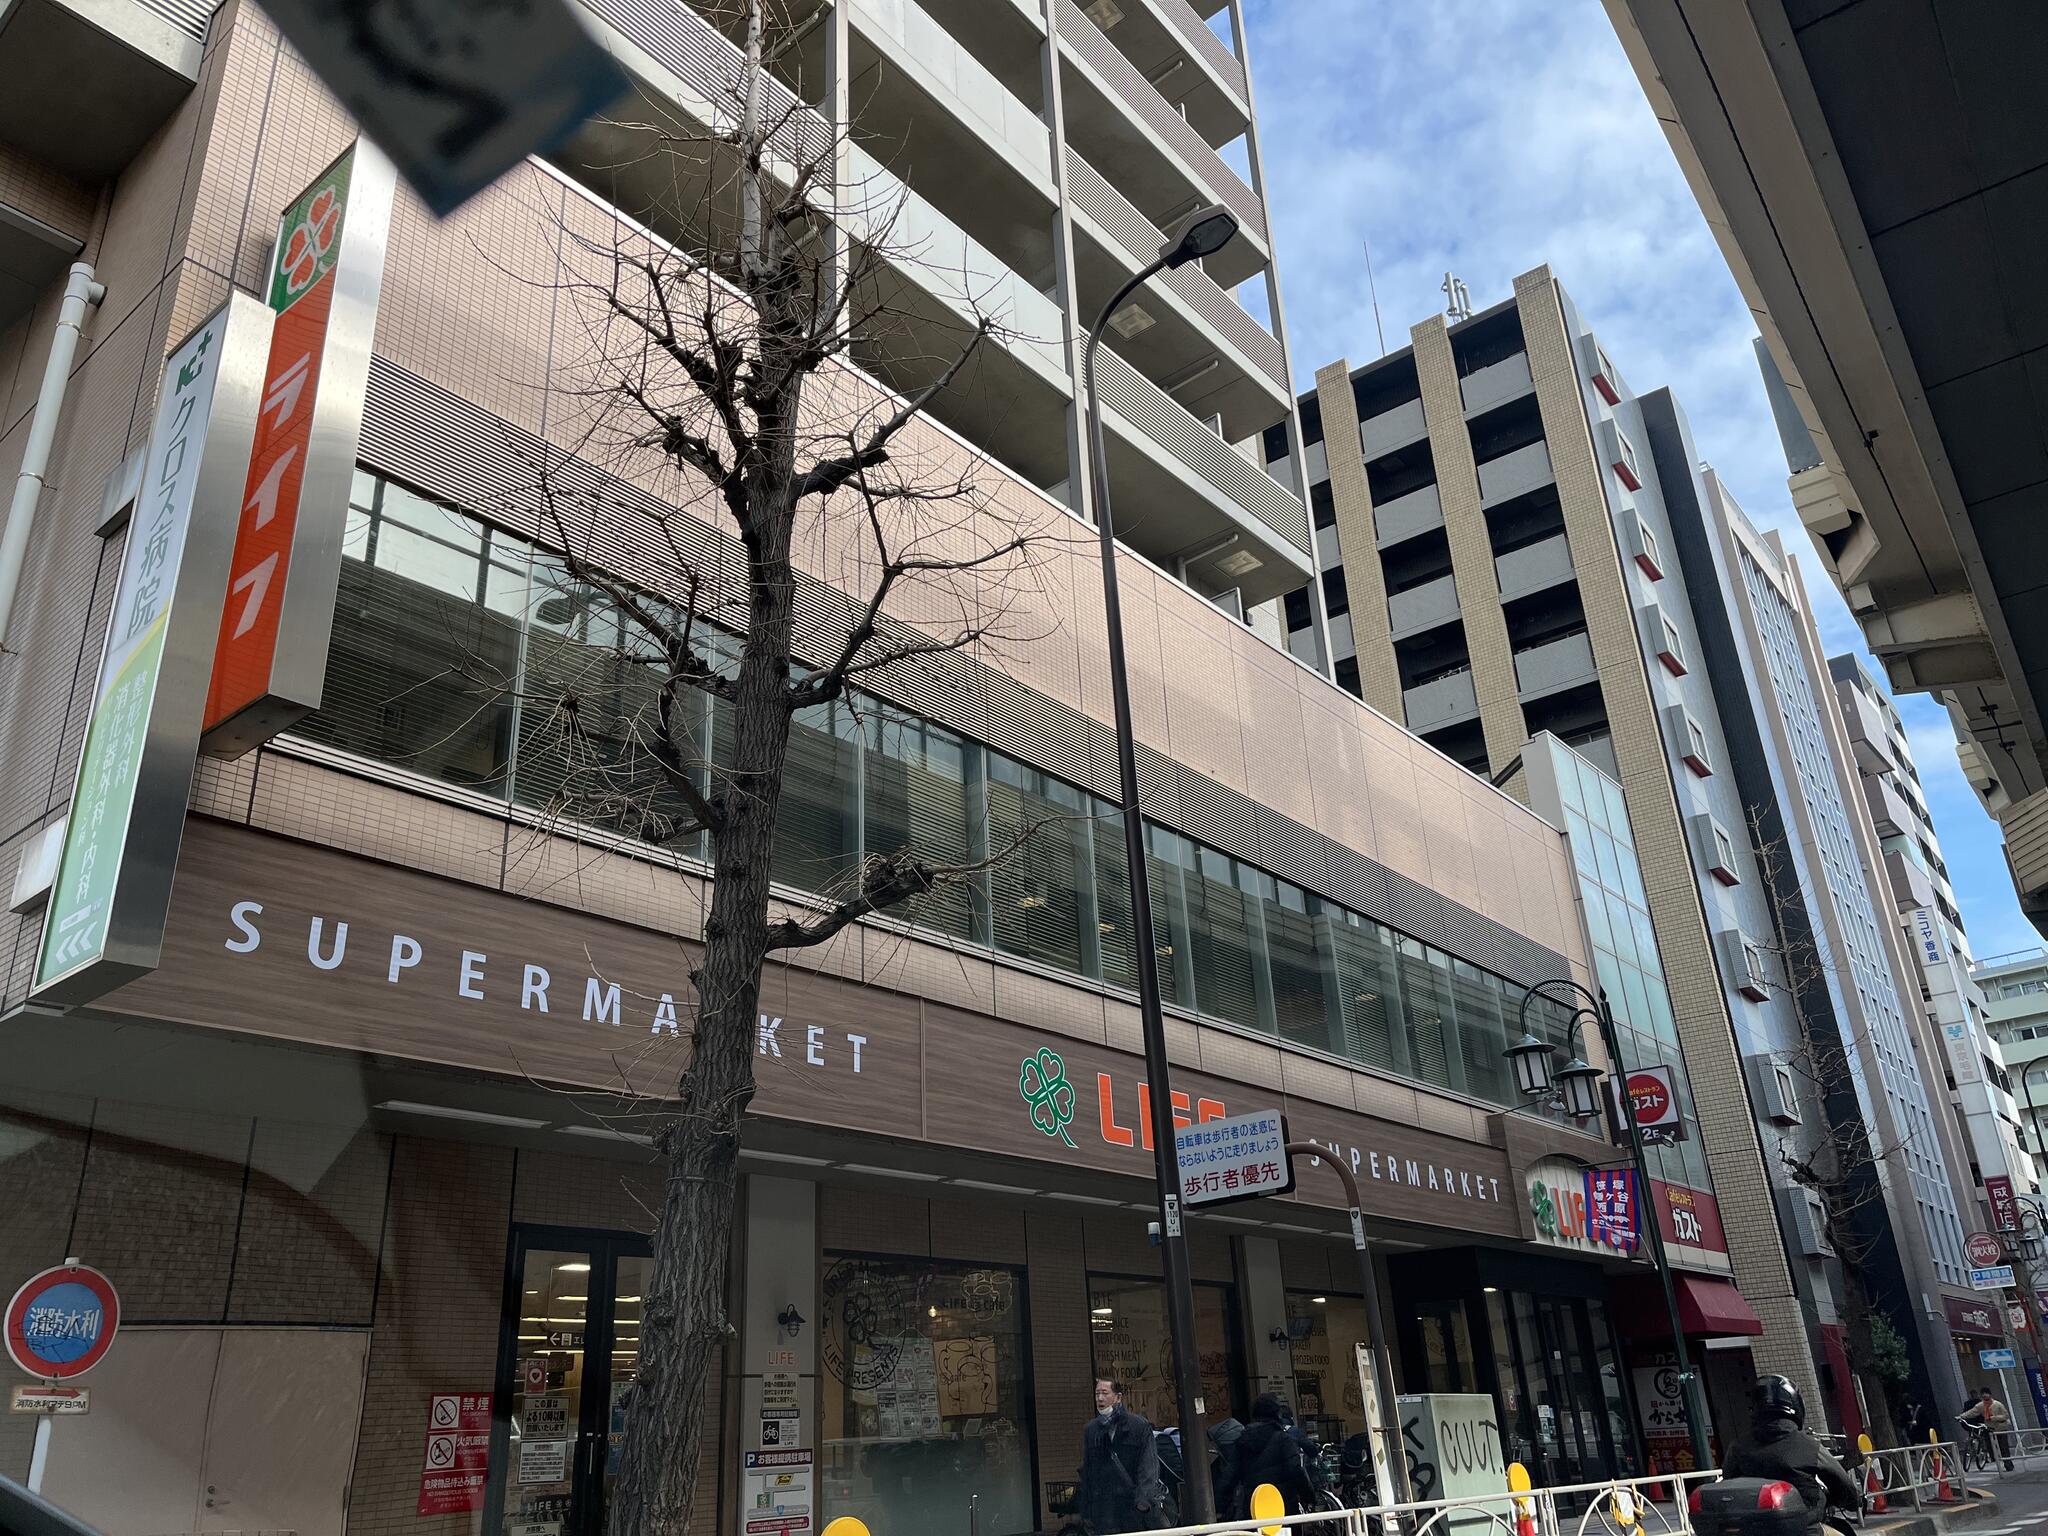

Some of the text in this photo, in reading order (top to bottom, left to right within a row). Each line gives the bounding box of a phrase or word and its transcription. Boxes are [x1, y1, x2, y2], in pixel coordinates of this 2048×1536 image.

[232, 351, 311, 641] ライフ
[128, 396, 196, 640] クロス病院
[115, 670, 148, 788] 整形外科
[224, 901, 868, 1074] SUPERMAKET
[1176, 1119, 1278, 1150] 自転車は歩行者の迷惑に
[1178, 1137, 1280, 1168] ならないように走りましょう
[1184, 1161, 1280, 1197] 歩行者優先
[1672, 1208, 1702, 1243] ガスト
[27, 1307, 100, 1340] 消防水利
[768, 1351, 794, 1365] LIFE
[462, 1396, 490, 1411] 禁煙
